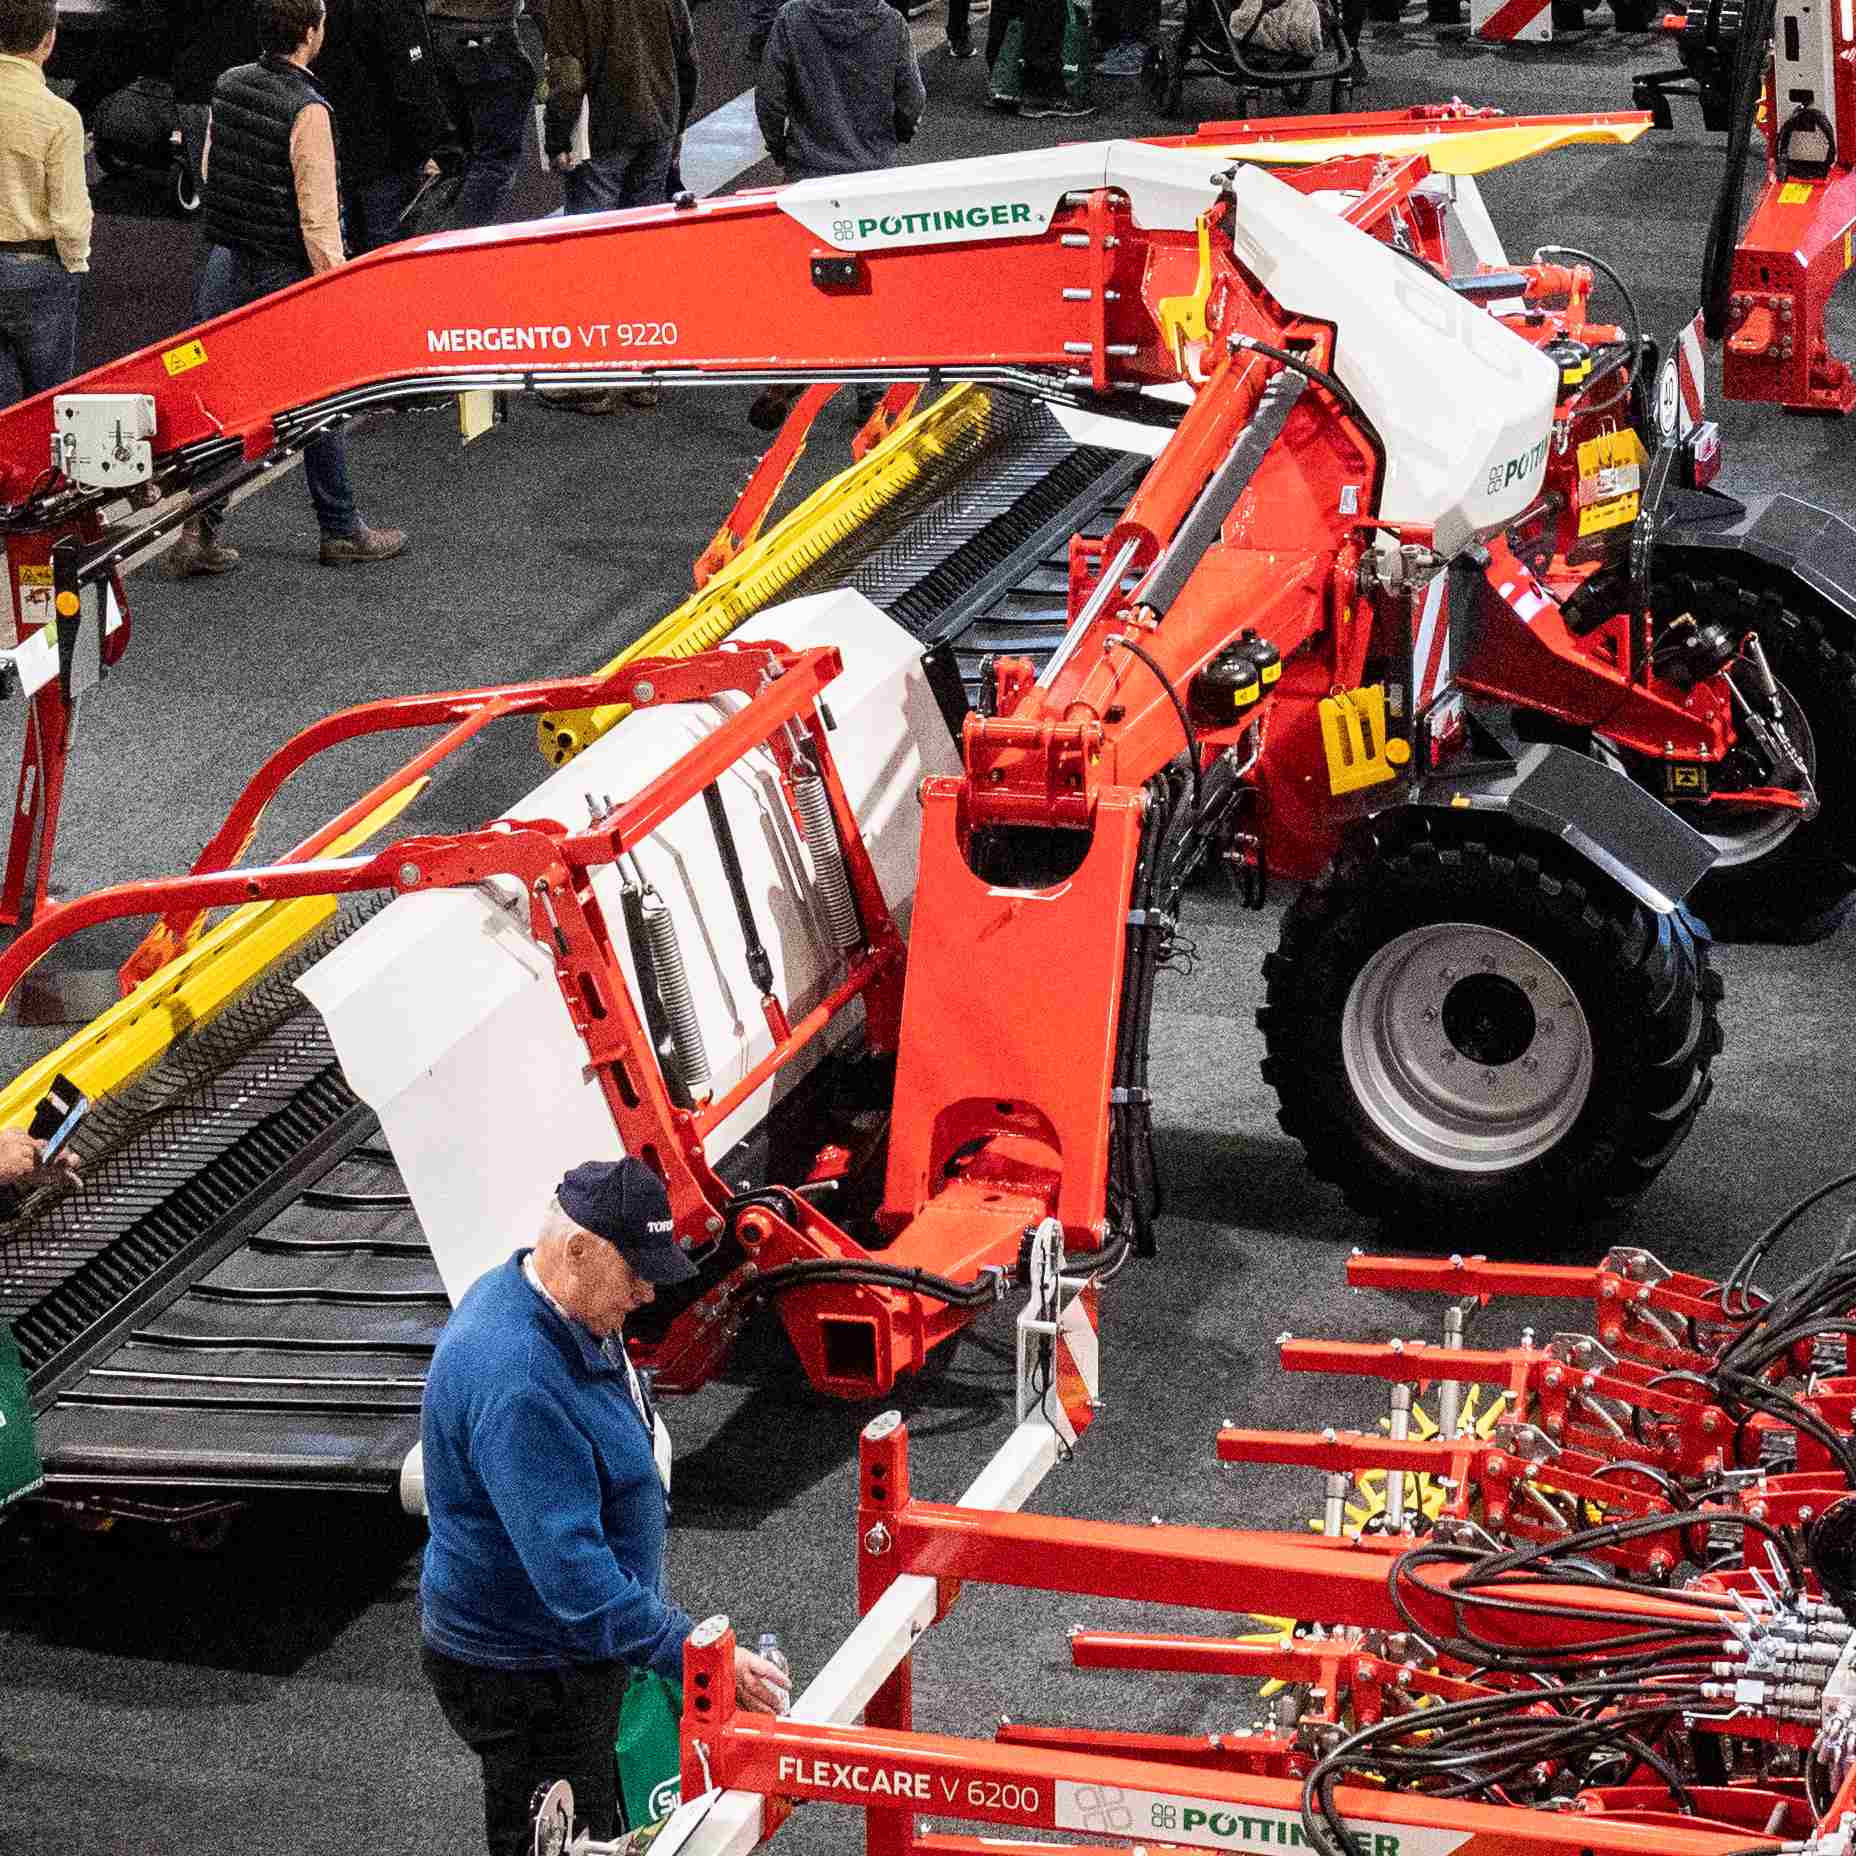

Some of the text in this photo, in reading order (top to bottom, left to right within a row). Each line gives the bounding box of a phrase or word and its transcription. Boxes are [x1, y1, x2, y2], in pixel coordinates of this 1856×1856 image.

[857, 202, 1032, 239] PÖTTINGER
[427, 323, 679, 353] MERGENTO VT 9220
[778, 1754, 1402, 1856] FLEXCARE V 6200 PÖTTINER
